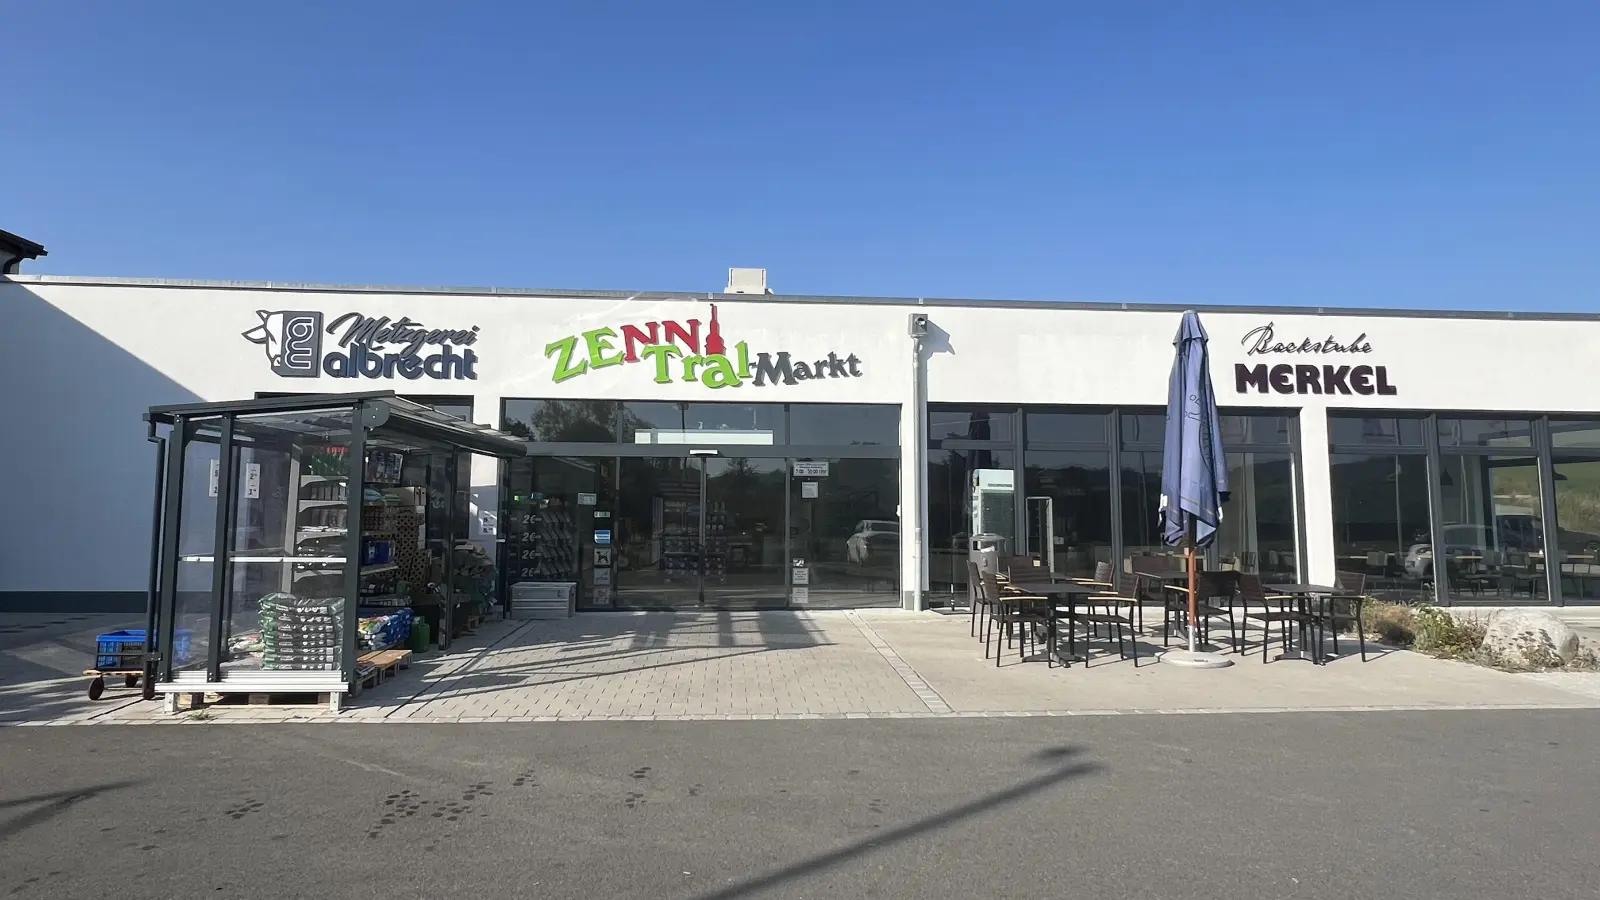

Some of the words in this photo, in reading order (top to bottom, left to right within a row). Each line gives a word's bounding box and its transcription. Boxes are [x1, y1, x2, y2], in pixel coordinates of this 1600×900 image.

[326, 312, 480, 358] Metzgerei
[1241, 321, 1374, 356] Backstube
[323, 342, 479, 380] albrecht
[1234, 363, 1398, 396] MERKEL
